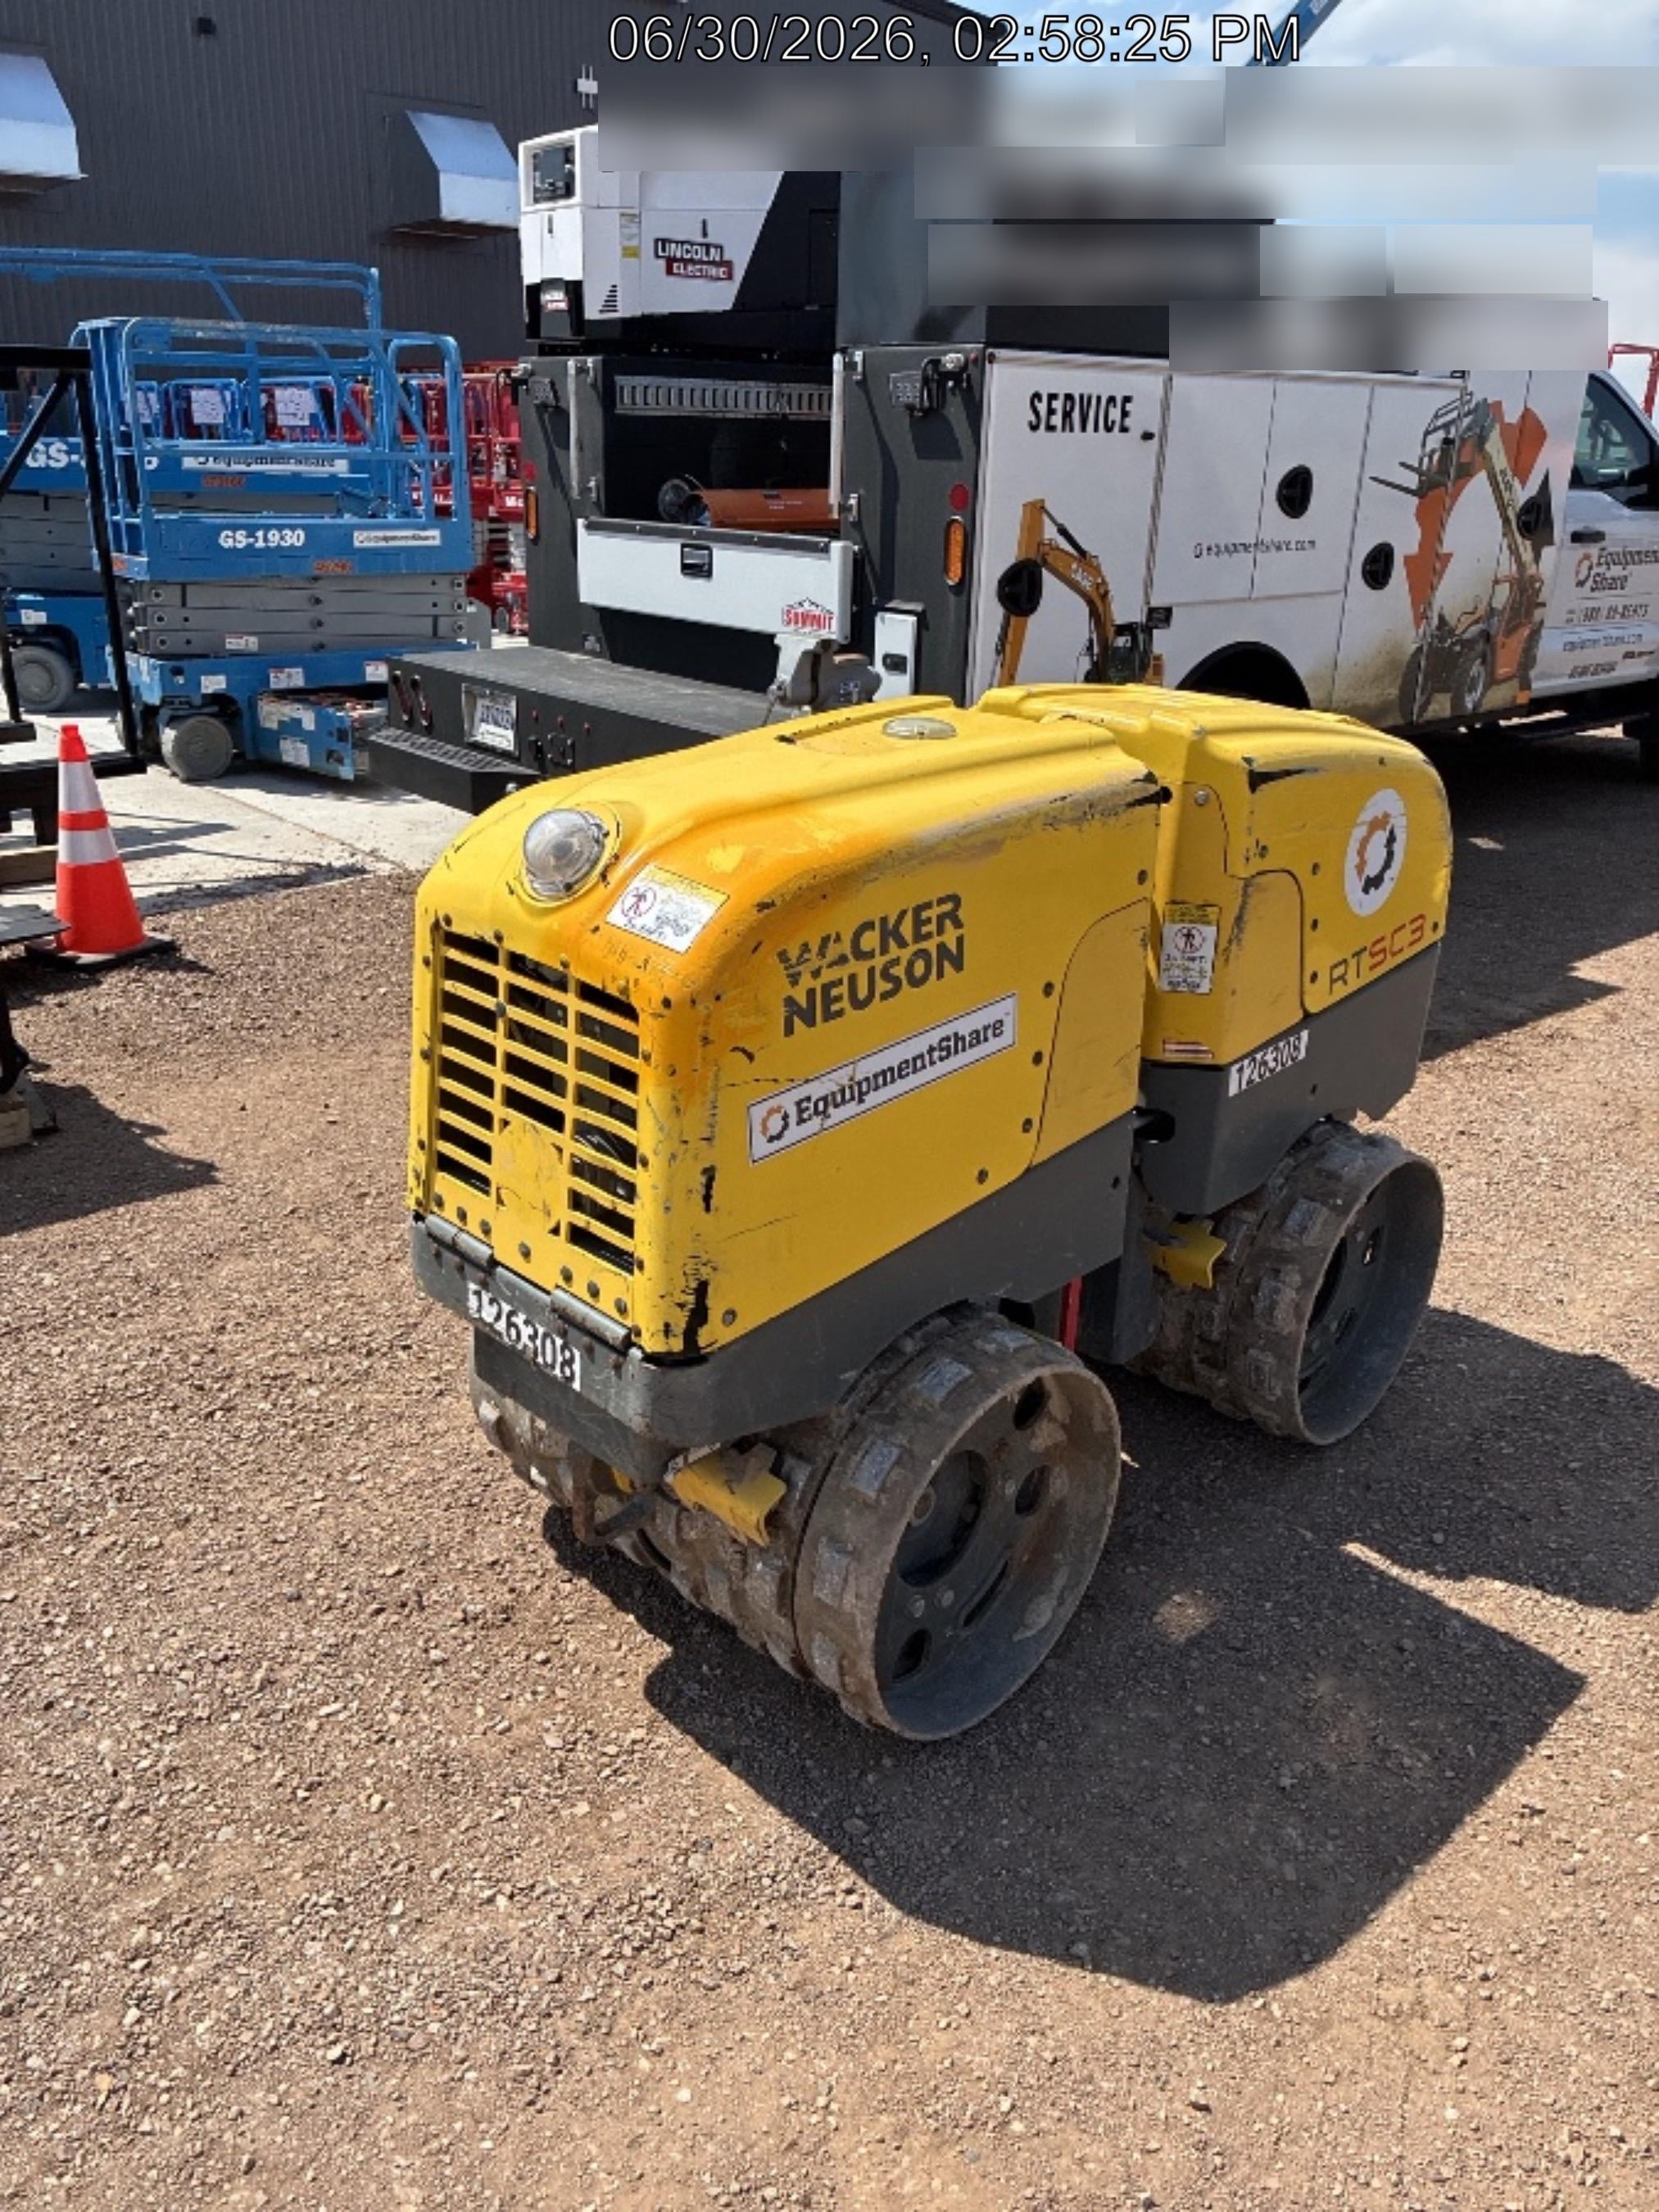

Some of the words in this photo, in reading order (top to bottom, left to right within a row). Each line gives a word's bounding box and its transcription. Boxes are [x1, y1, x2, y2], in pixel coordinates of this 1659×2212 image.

[658, 240, 721, 261] LINCOLN
[1027, 390, 1134, 433] SERVICE
[218, 529, 306, 549] GS-1930
[777, 892, 964, 987] WACKER
[1329, 913, 1426, 996] RTSC3
[782, 934, 965, 1038] NEUSON
[793, 1018, 1005, 1126] EquipmentShare
[1234, 1035, 1303, 1090] 126308
[472, 1289, 576, 1383] 126308
